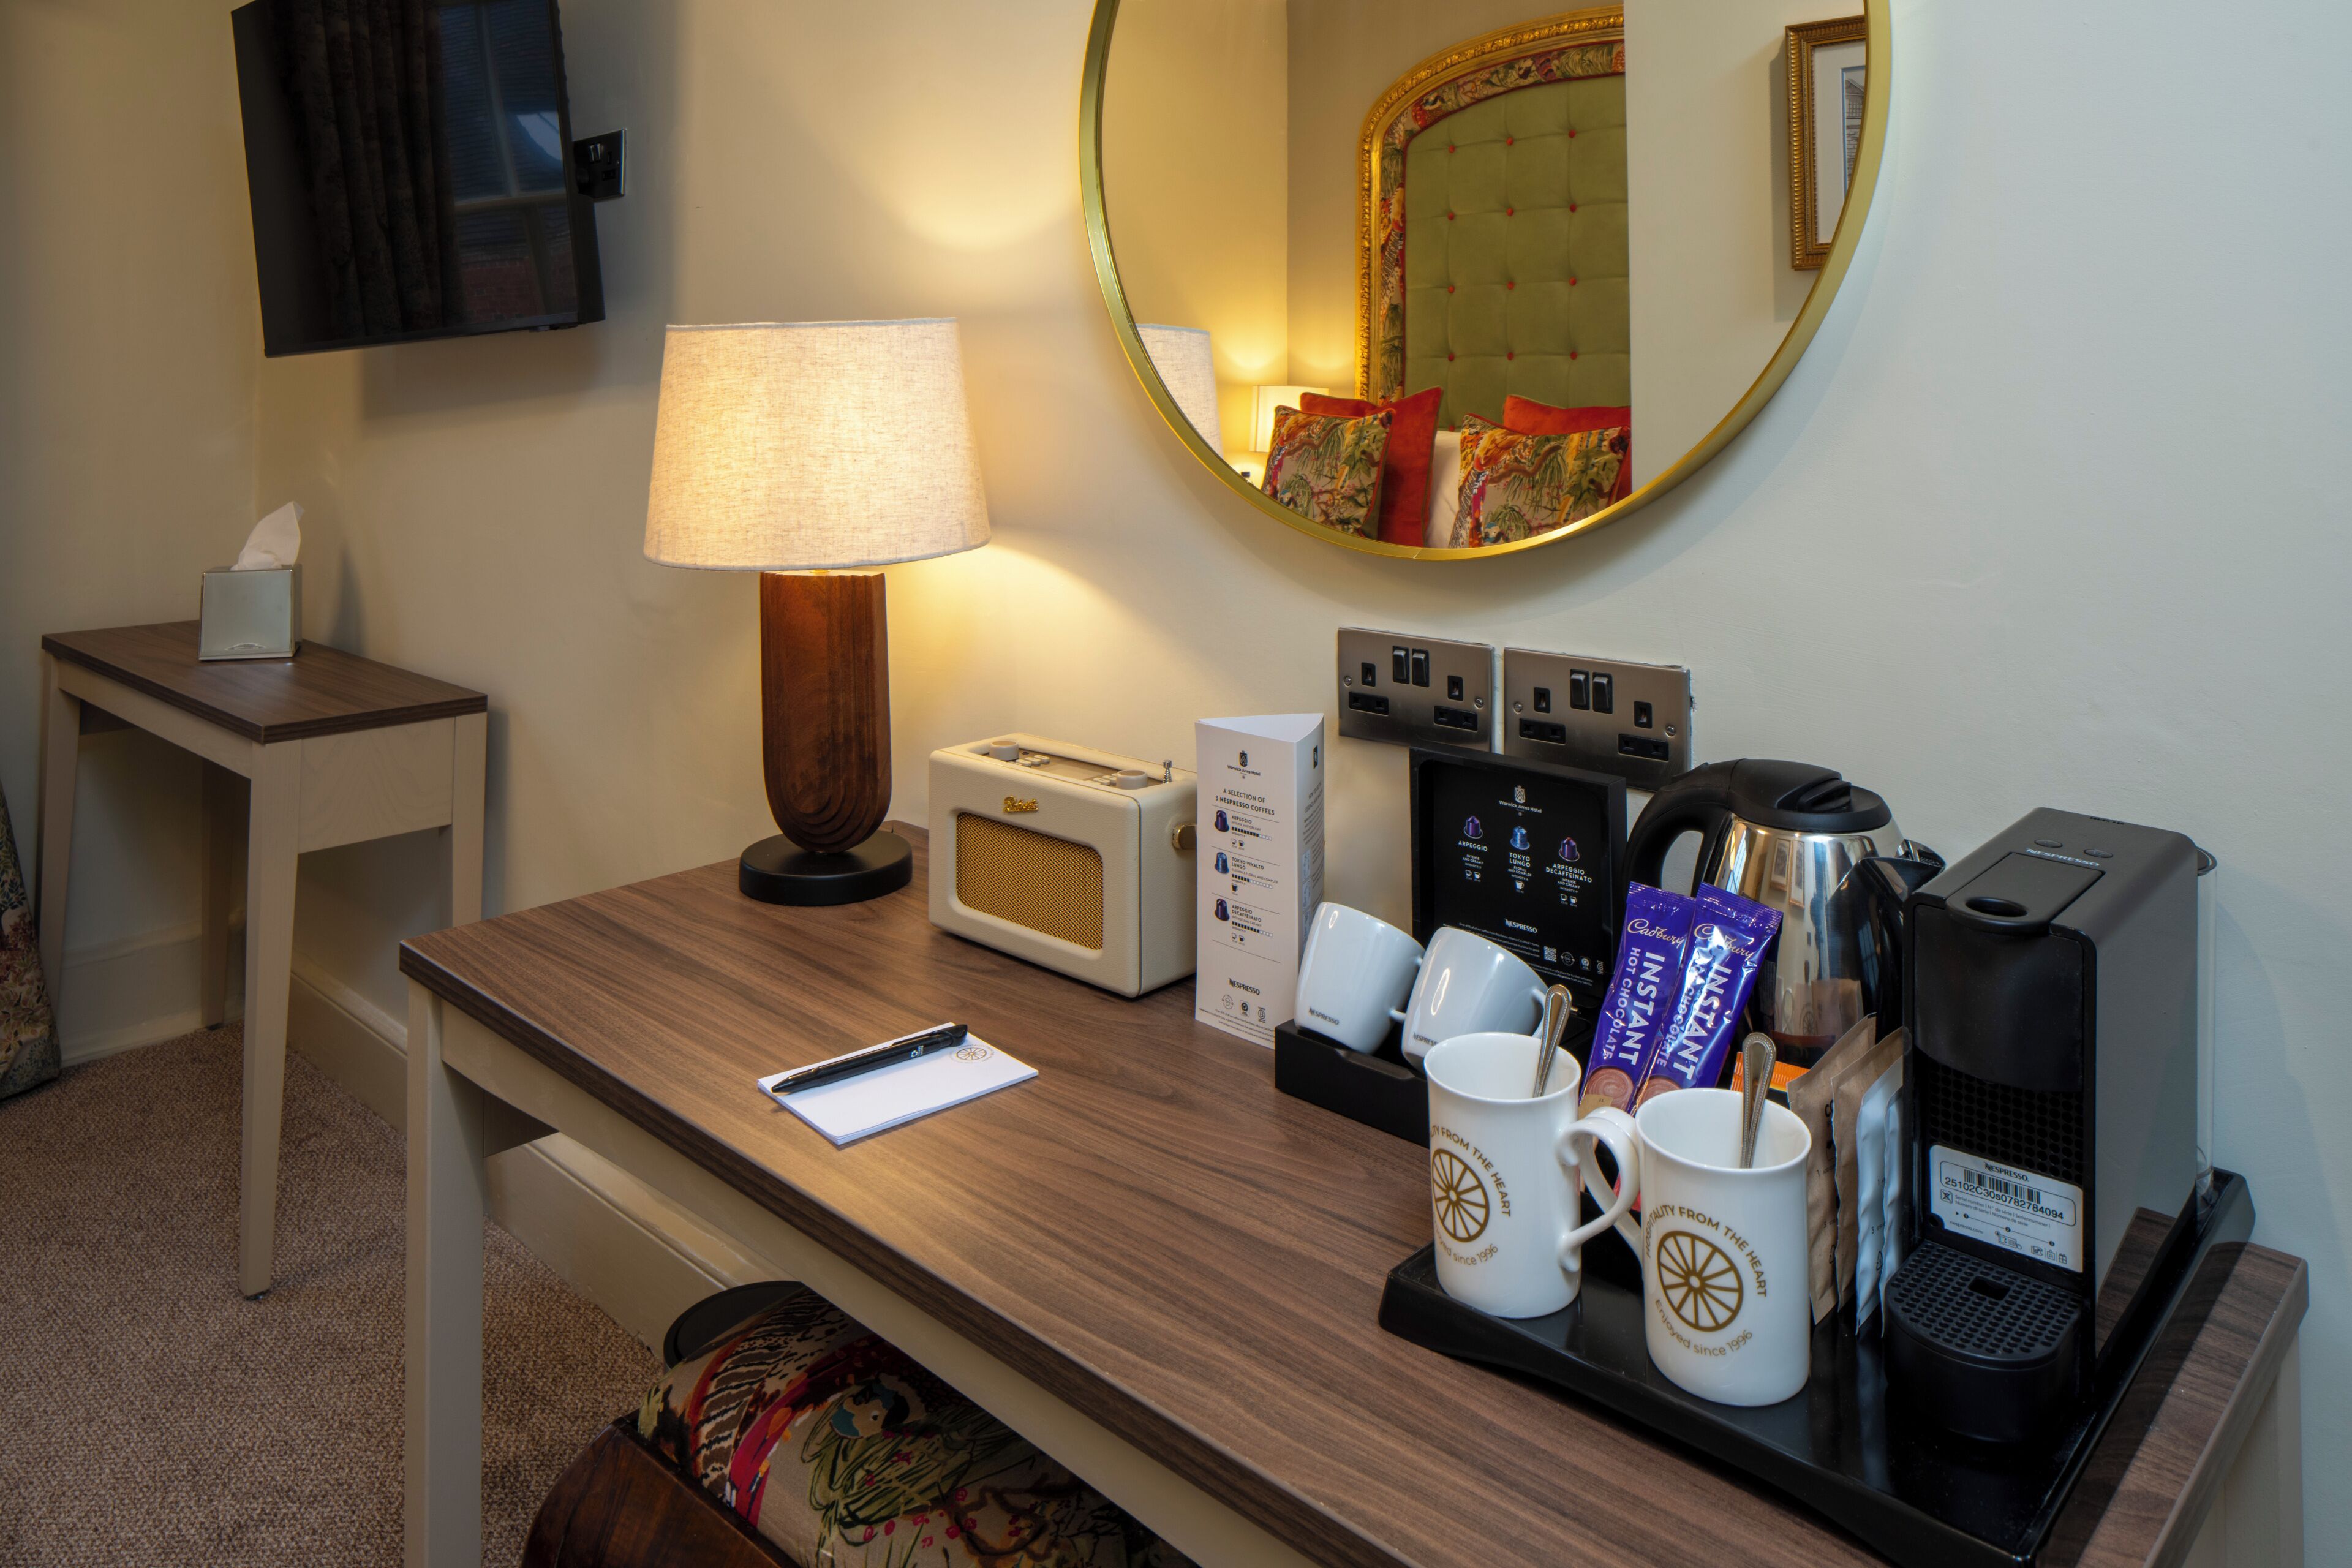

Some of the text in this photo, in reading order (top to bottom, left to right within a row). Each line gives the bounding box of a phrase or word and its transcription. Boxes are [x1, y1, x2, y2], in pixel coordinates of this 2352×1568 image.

[1228, 789, 1256, 801] SELECTION
[1220, 797, 1249, 809] NESPRESSO
[1251, 805, 1275, 815] COFFEES
[1232, 815, 1251, 824] ARPEGGIO
[1458, 840, 1488, 851] ARPEGGIO
[1246, 861, 1264, 870] VIVALTO
[1509, 852, 1530, 862] TOKYO
[1509, 858, 1530, 867] LUNGO
[2026, 848, 2100, 866] NESPRESSO
[1546, 867, 1592, 883] DECAFFEINATO
[1553, 864, 1585, 875] ARPEGGIO
[1232, 905, 1252, 914] ARPEGGIO
[1232, 910, 1261, 922] DECAFFEINATO
[1505, 919, 1537, 933] NESPRESSO
[1627, 918, 1685, 949] Cadbury
[1229, 978, 1260, 995] NESPRESSO
[1603, 947, 1641, 1058] HOT CHOCOLATE
[1618, 952, 1665, 1065] INSTANT
[1309, 1006, 1339, 1025] NESPRESSO
[1673, 963, 1732, 1080] INSTANT
[1441, 1127, 1511, 1217] FROM THE HEART
[1984, 1161, 2028, 1182] NESPRESSO
[1945, 1177, 2064, 1220] 25102C30s0782784094
[1968, 1199, 1985, 1208] number
[2015, 1213, 2048, 1227] Seriennummer
[1950, 1221, 1983, 1234] nespresso.com
[1453, 1253, 1477, 1265] since
[1477, 1243, 1499, 1263] 1996
[1646, 1205, 1768, 1297] HOSPITALITY FROM THE HEART
[1655, 1298, 1753, 1357] Enjoyed since 1996
